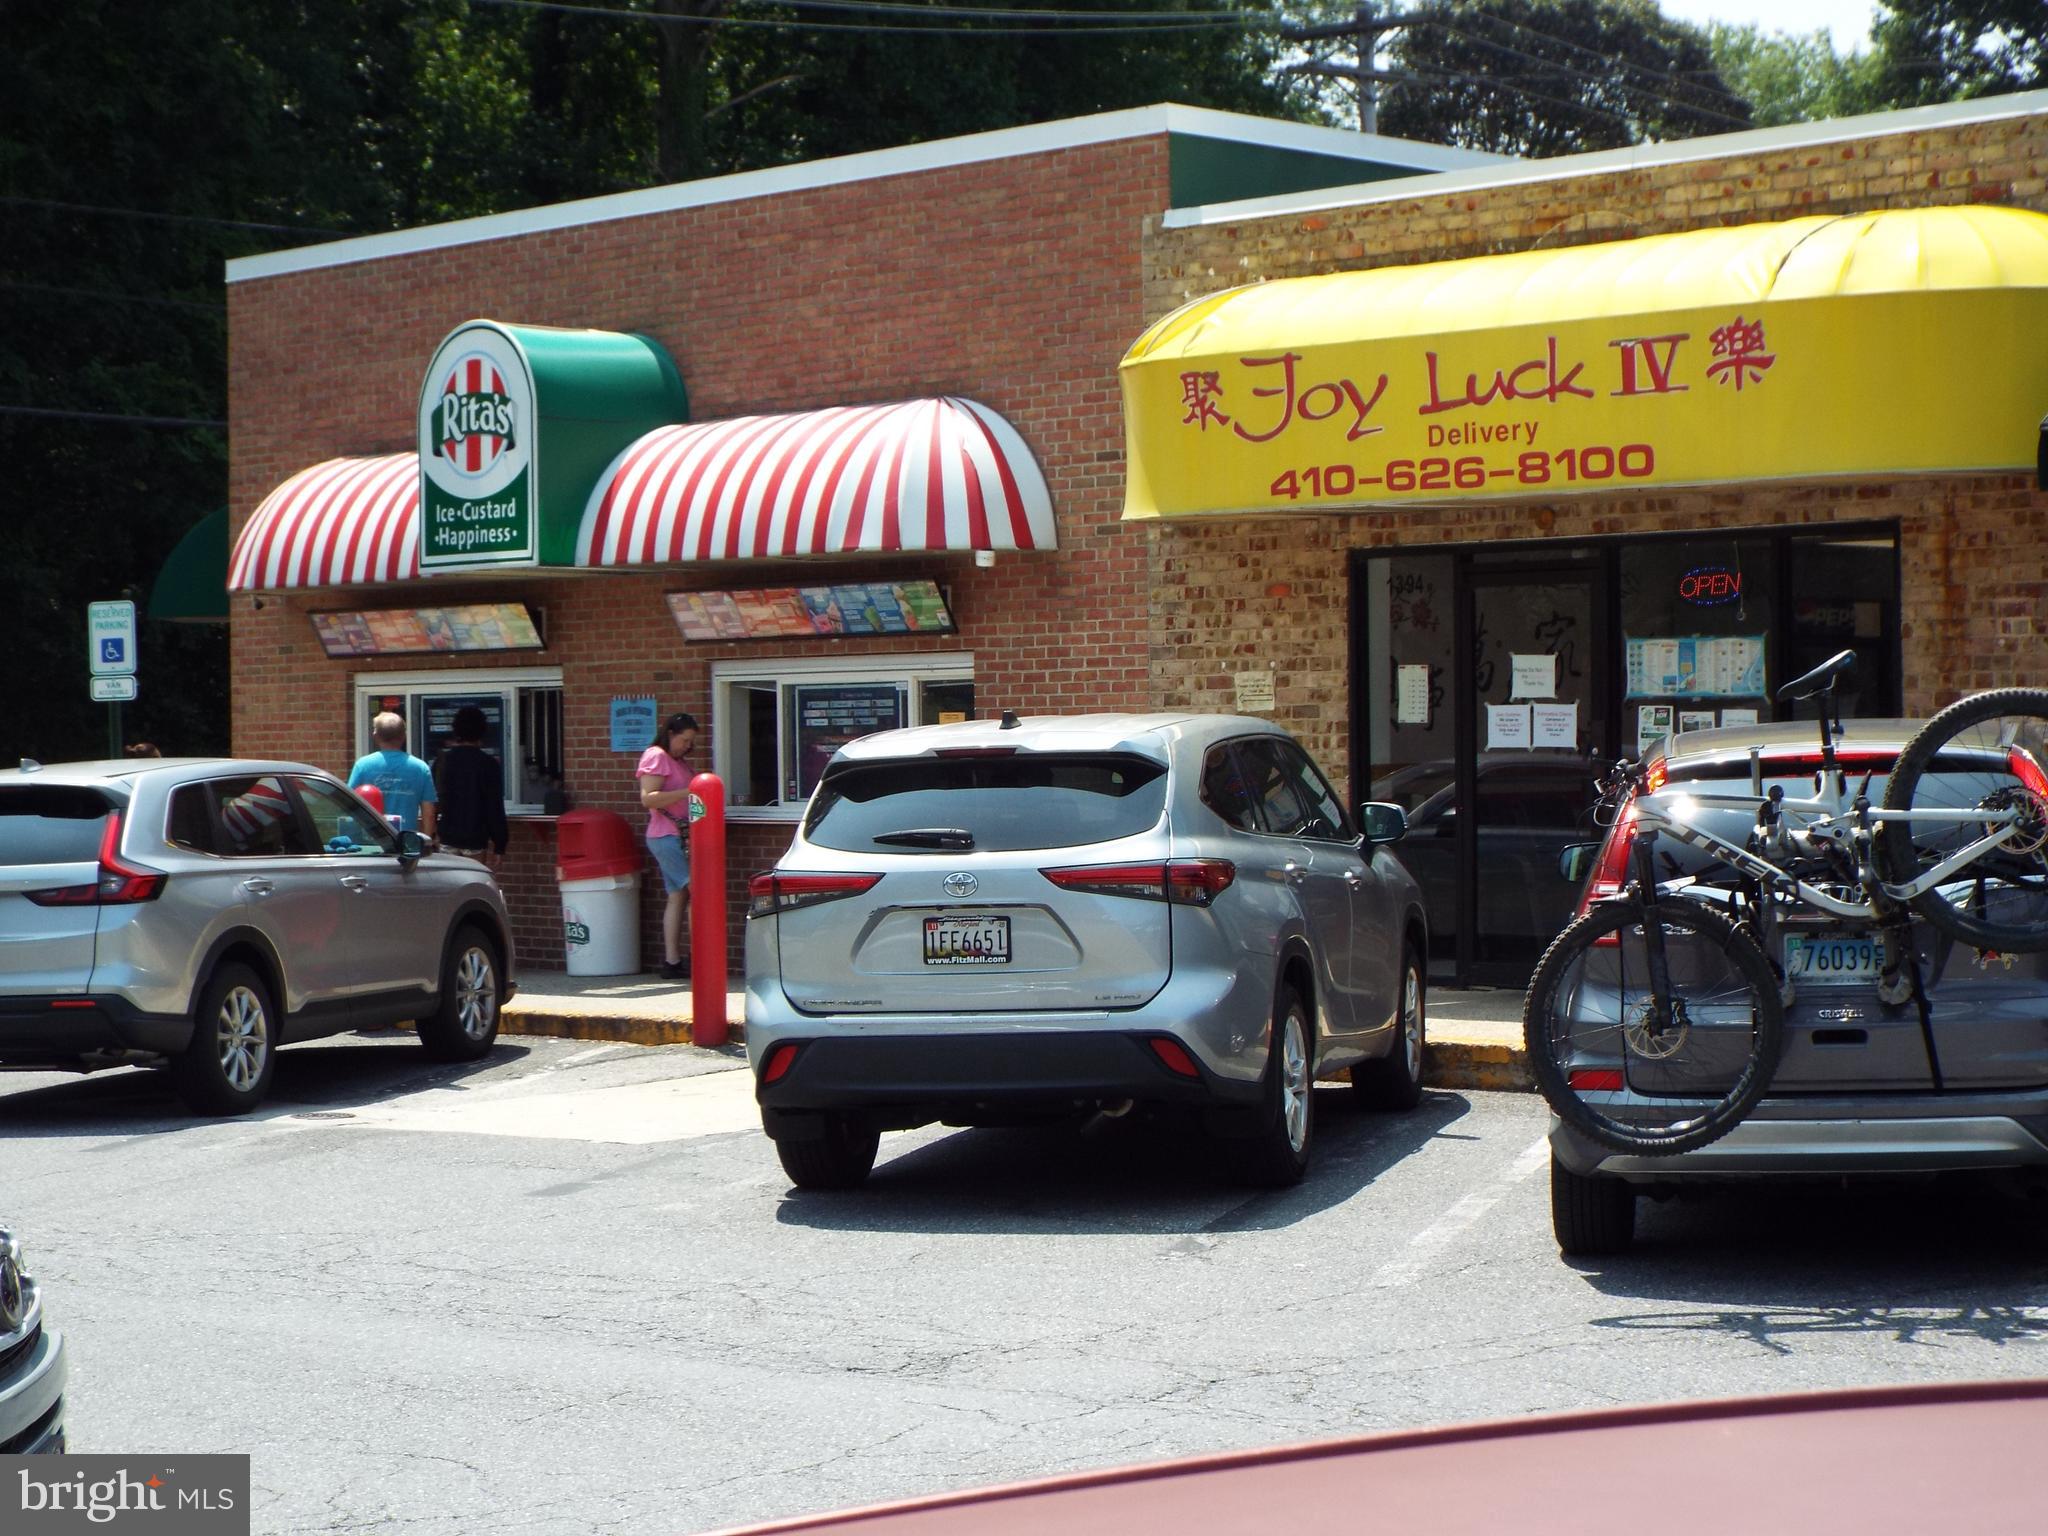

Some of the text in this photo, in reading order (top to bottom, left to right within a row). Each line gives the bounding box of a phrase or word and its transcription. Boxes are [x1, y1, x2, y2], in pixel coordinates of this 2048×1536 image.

[1233, 333, 1690, 442] Joy Luck IV
[1179, 371, 1231, 432] 聚
[441, 393, 510, 442] Rita's
[1428, 421, 1539, 447] Delivery
[1270, 444, 1654, 499] 410-626-8100
[439, 526, 511, 550] Happiness
[1679, 572, 1741, 598] OPEN
[1814, 610, 1854, 626] PEP
[106, 681, 121, 689] VAN
[927, 956, 1007, 964] www.FitzMall.com
[1803, 945, 1871, 971] 76039
